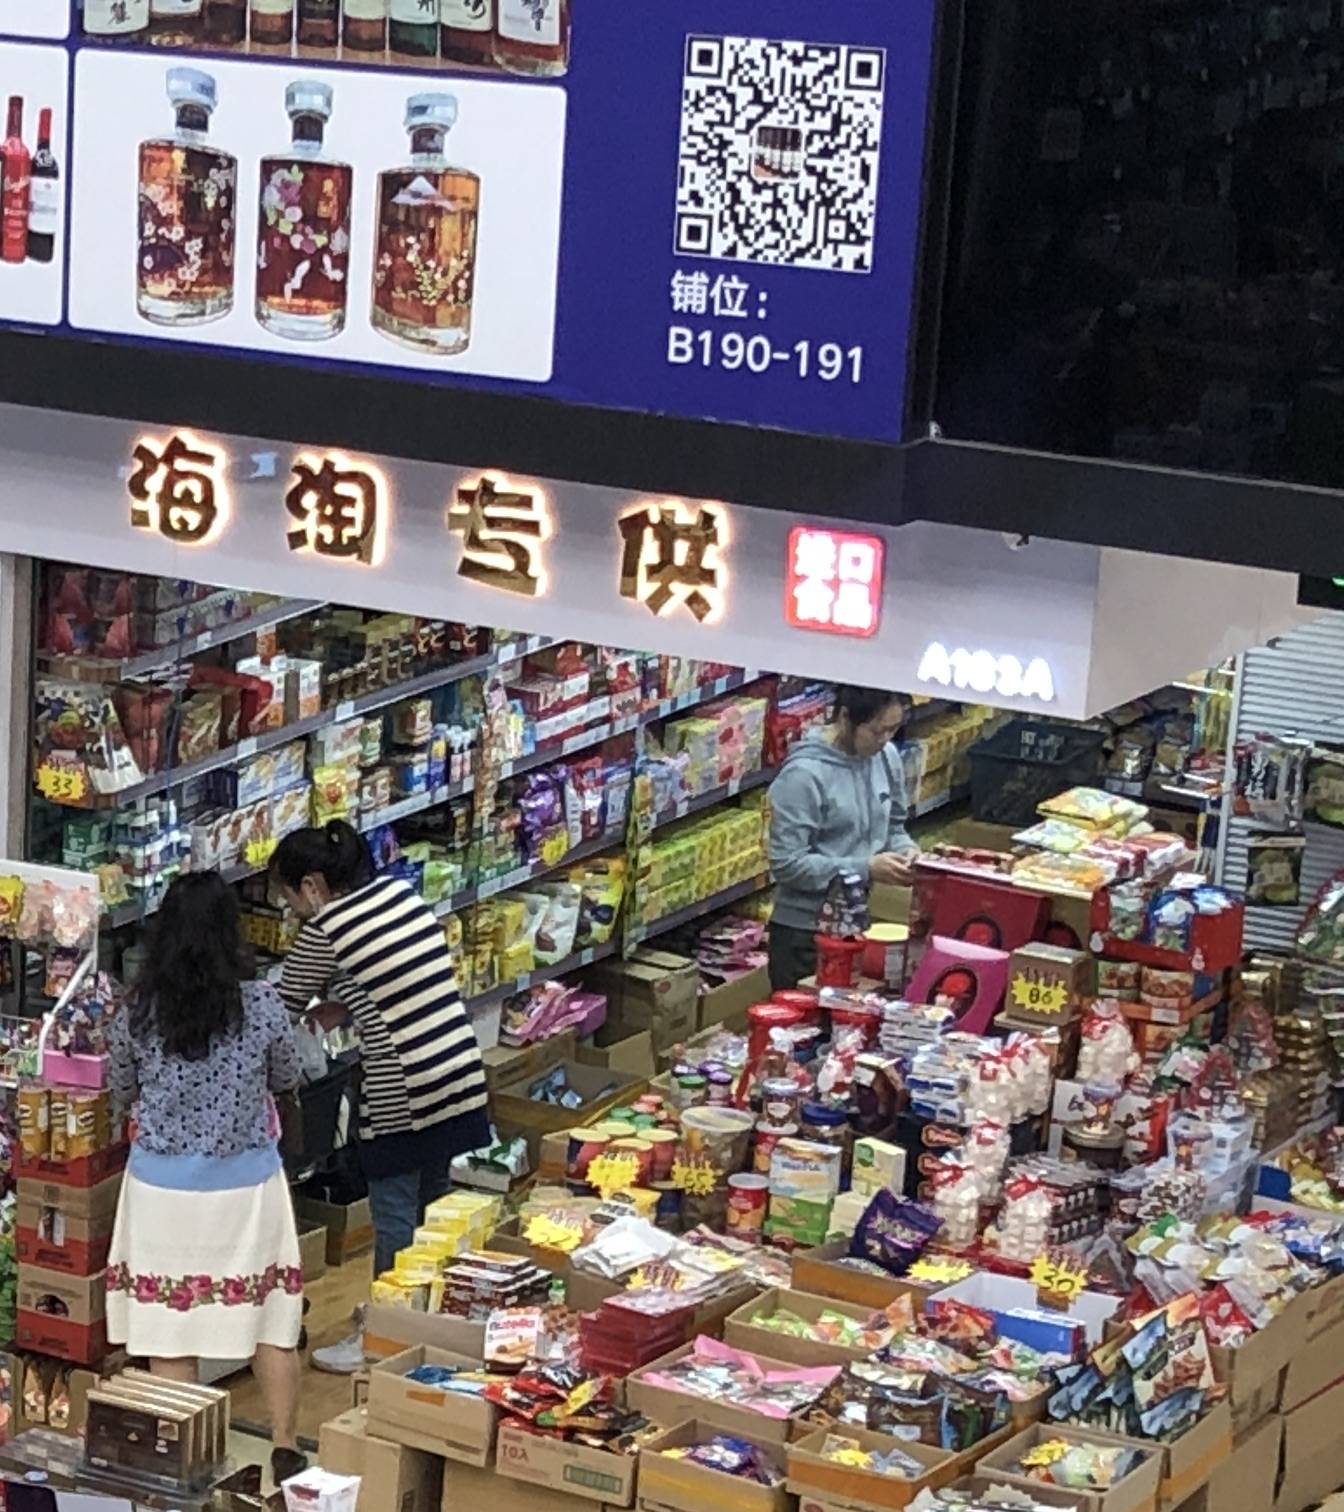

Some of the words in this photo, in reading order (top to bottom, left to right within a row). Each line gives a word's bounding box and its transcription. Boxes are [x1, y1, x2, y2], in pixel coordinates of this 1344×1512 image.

[666, 326, 864, 383] B190-191
[126, 433, 726, 624] 海淘专供
